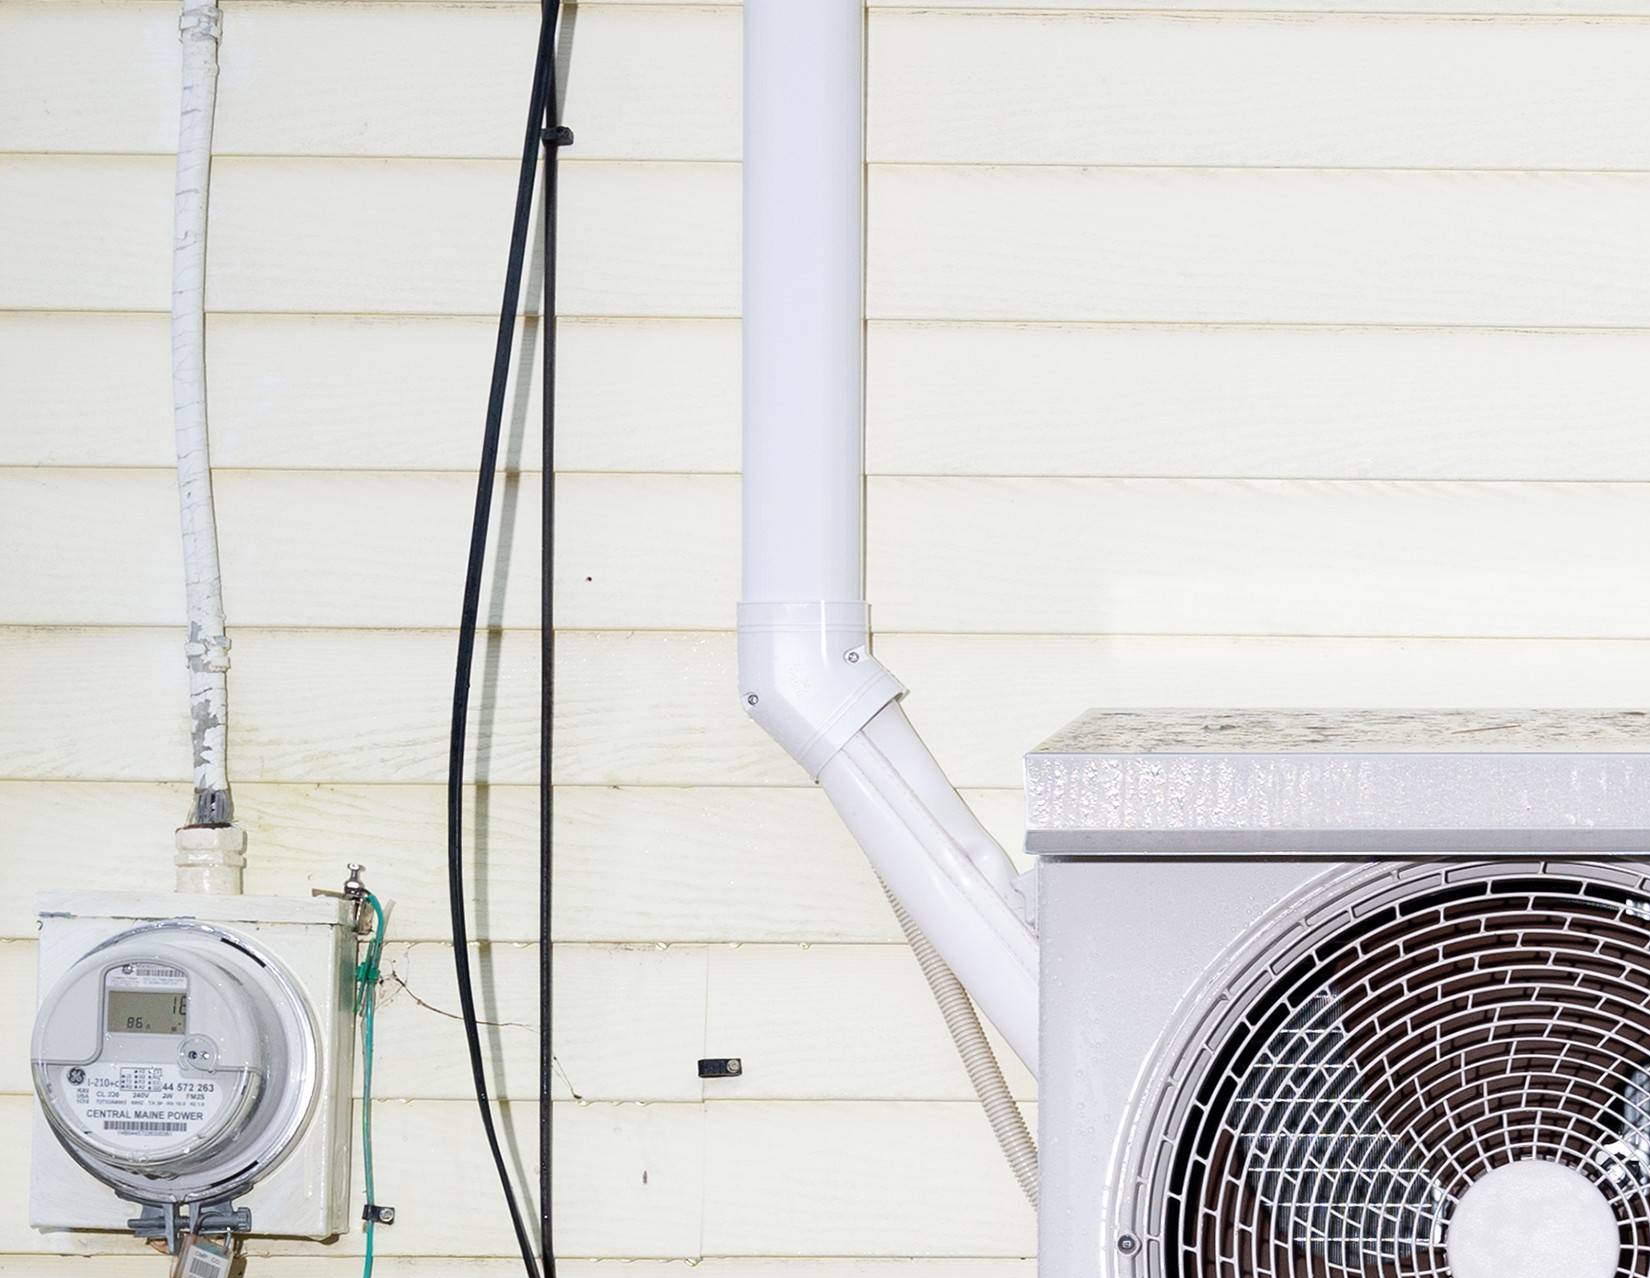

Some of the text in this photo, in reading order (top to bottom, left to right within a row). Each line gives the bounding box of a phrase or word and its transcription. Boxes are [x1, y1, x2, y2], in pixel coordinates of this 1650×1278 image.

[162, 1083, 214, 1092] 44 572 263
[87, 1109, 203, 1120] CENTRAL MAINE POWER
